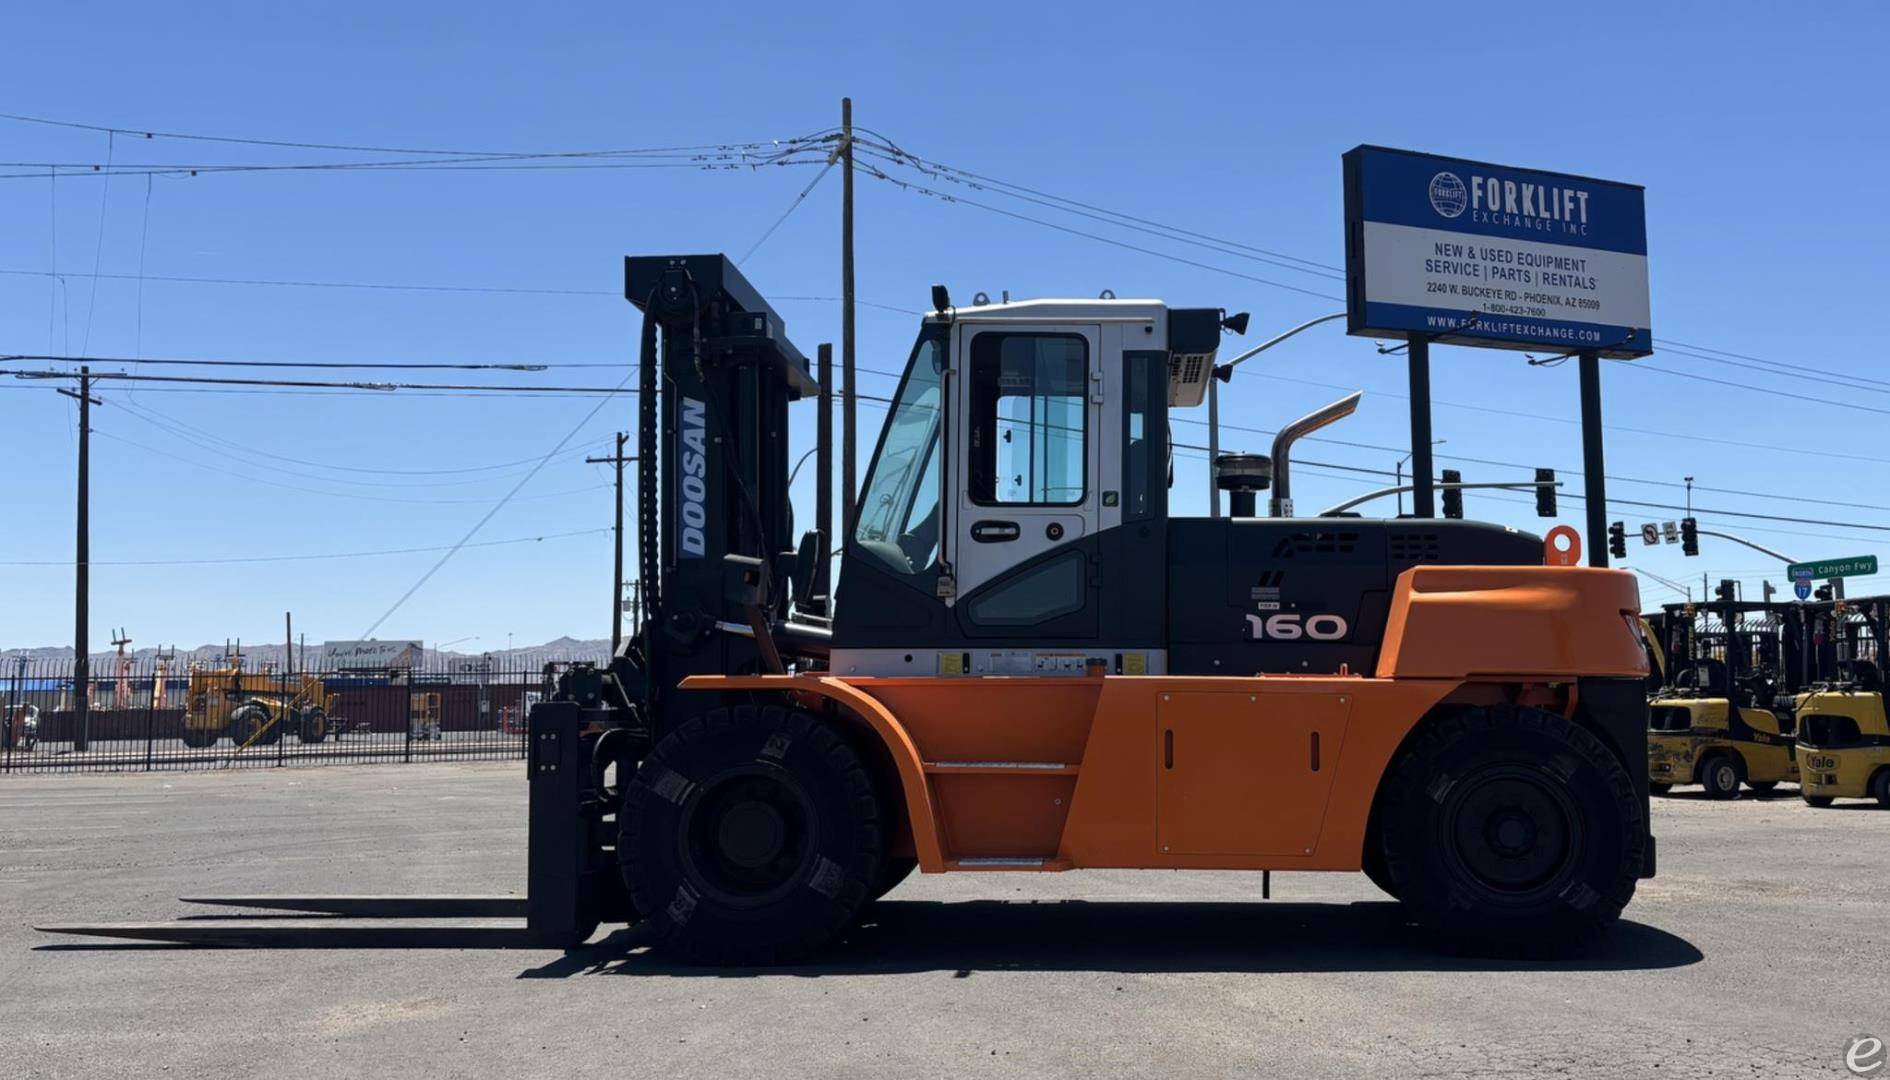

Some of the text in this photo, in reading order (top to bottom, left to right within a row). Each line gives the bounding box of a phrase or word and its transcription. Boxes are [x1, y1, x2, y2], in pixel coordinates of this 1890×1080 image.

[1471, 176, 1589, 223] FORKLIFT
[1473, 211, 1587, 236] EXCHANGE INC
[1435, 242, 1586, 272] NEW & USED EQUIPMENT
[1425, 259, 1480, 277] SERVICE
[1491, 266, 1531, 283] PARTS
[1542, 272, 1597, 290] RENTALS
[1426, 282, 1447, 293] 2240
[1449, 285, 1460, 295] W.
[1461, 285, 1503, 300] BUCKEYE
[1504, 290, 1517, 301] RD
[1564, 297, 1577, 307] AZ
[1482, 303, 1546, 317] 1-800-423-7600
[682, 397, 706, 556] DOOSAN
[1818, 564, 1852, 575] Canyon
[1854, 562, 1873, 571] Fwy
[1798, 587, 1808, 597] 17
[1245, 614, 1348, 640] 160
[1811, 755, 1834, 768] Yale
